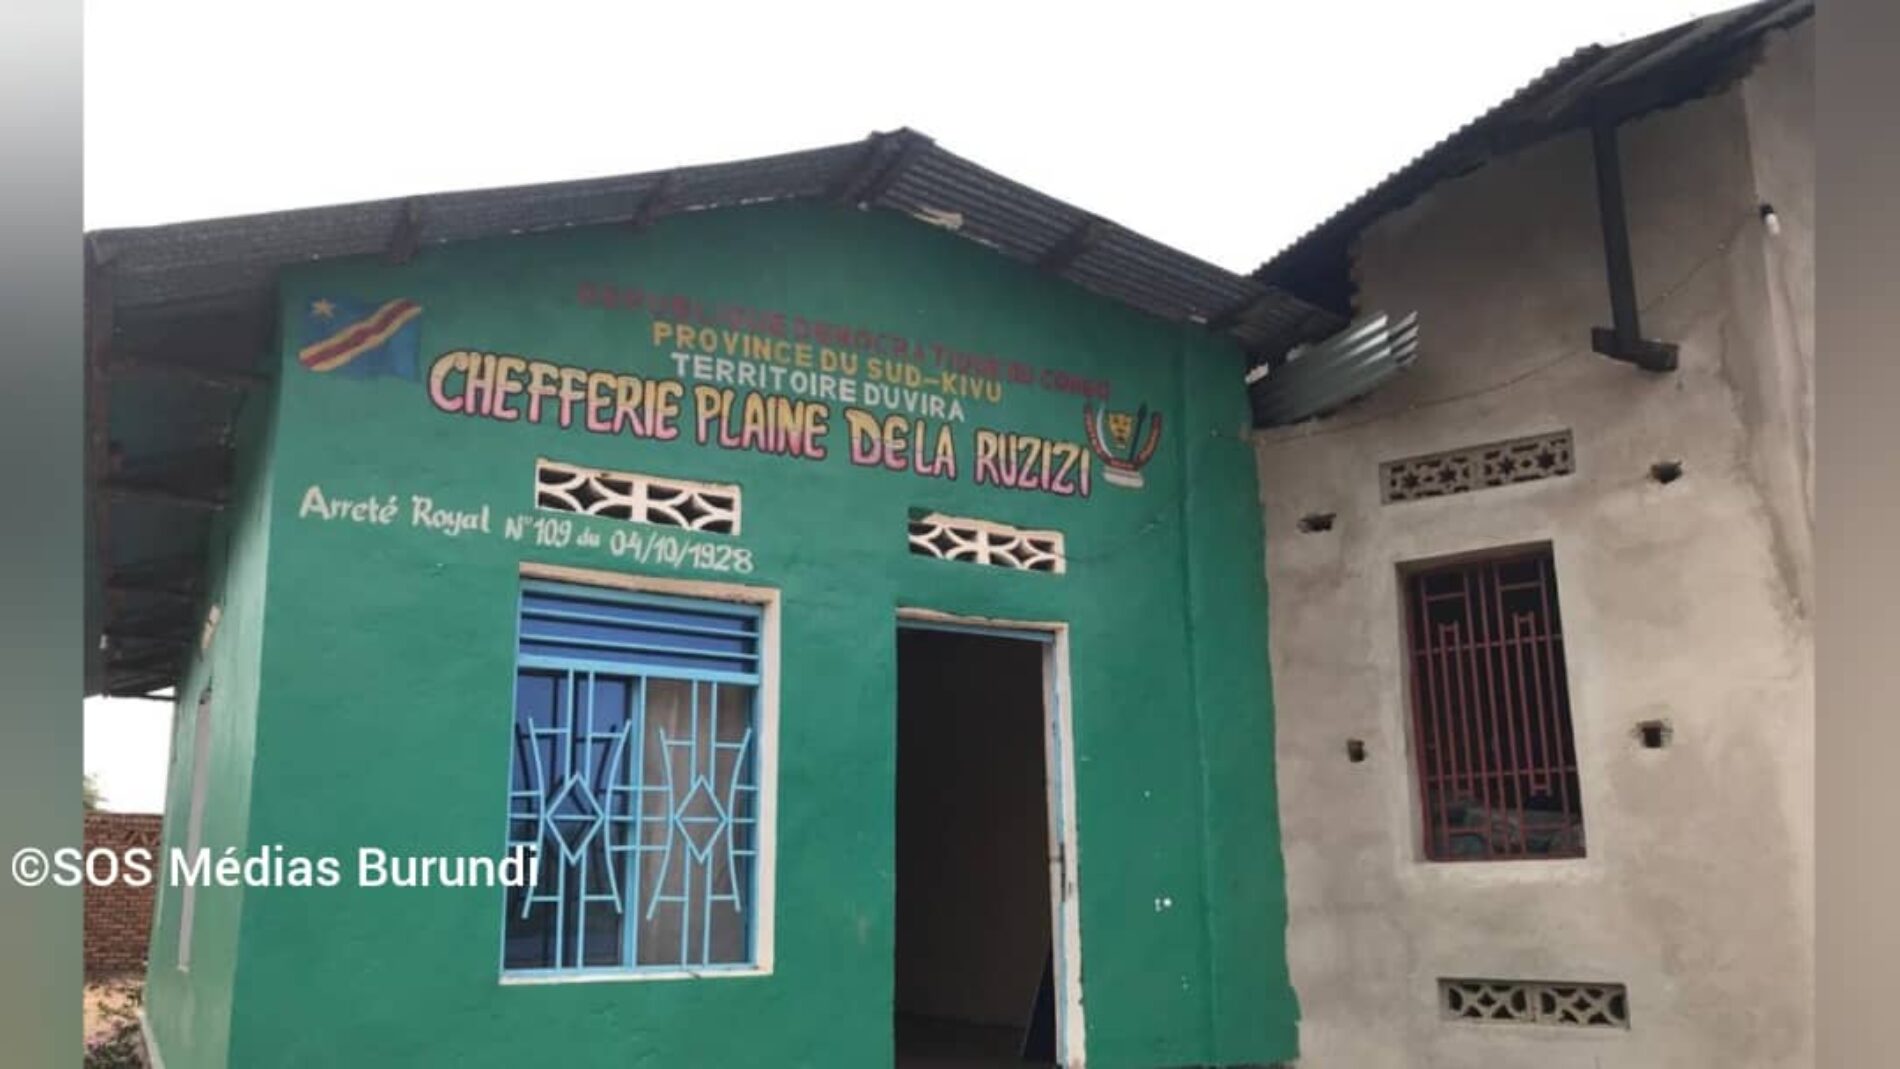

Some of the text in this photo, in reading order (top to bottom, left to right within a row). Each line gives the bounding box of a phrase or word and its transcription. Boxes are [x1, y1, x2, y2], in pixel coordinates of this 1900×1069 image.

[652, 320, 1003, 403] PROVINCE DU SUD-KIVU
[670, 351, 857, 403] TERRITOIRE
[428, 350, 684, 441] CHEFFERIE
[694, 385, 829, 462] PLAINE
[973, 426, 1093, 499] RUZIZI
[299, 484, 398, 525] Arreté
[411, 494, 491, 537] Royal
[576, 527, 600, 547] du
[610, 529, 754, 574] 04/10/1928
